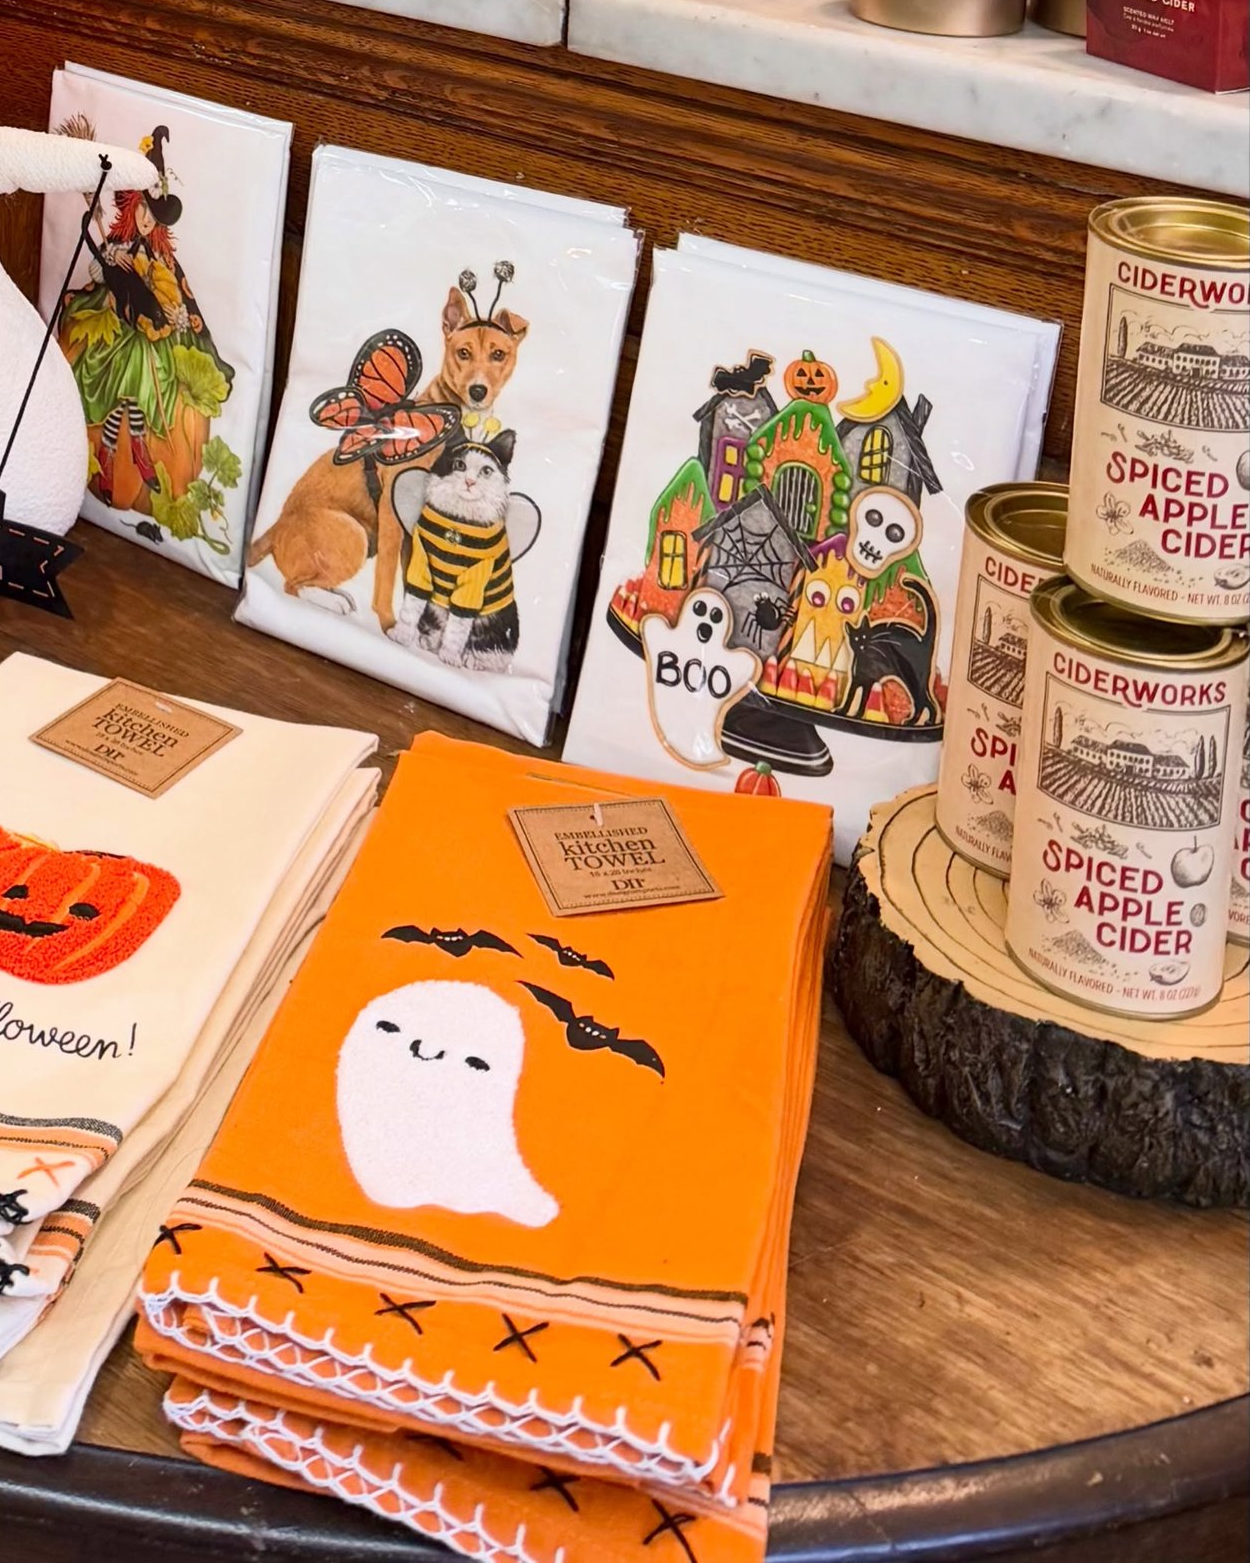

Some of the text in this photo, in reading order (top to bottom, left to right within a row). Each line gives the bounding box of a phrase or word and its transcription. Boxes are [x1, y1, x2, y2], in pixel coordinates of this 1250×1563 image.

[1118, 261, 1250, 309] CIDERWO
[1106, 451, 1229, 498] SPICED
[1138, 493, 1249, 530] APPLE
[985, 556, 1045, 595] CIDE
[1091, 564, 1132, 590] NATURALLY
[1133, 582, 1179, 602] FLAVORED
[1187, 593, 1205, 605] NET
[1224, 594, 1230, 605] 8
[1231, 594, 1242, 605] OZ
[656, 651, 732, 699] BOO
[1053, 652, 1228, 709] CIDERWORKS
[92, 717, 166, 757] TOWEL
[102, 708, 178, 748] kitchen
[115, 703, 190, 738] EMBELLISHED
[554, 826, 648, 841] EMBELLISHED
[559, 838, 657, 856] kitchen
[564, 851, 665, 871] TOWEL
[1042, 839, 1164, 895] SPICED
[1074, 892, 1184, 927] APPLE
[1096, 922, 1193, 956] CIDER
[1069, 971, 1114, 994] FLAVORED
[1122, 987, 1140, 999] NET
